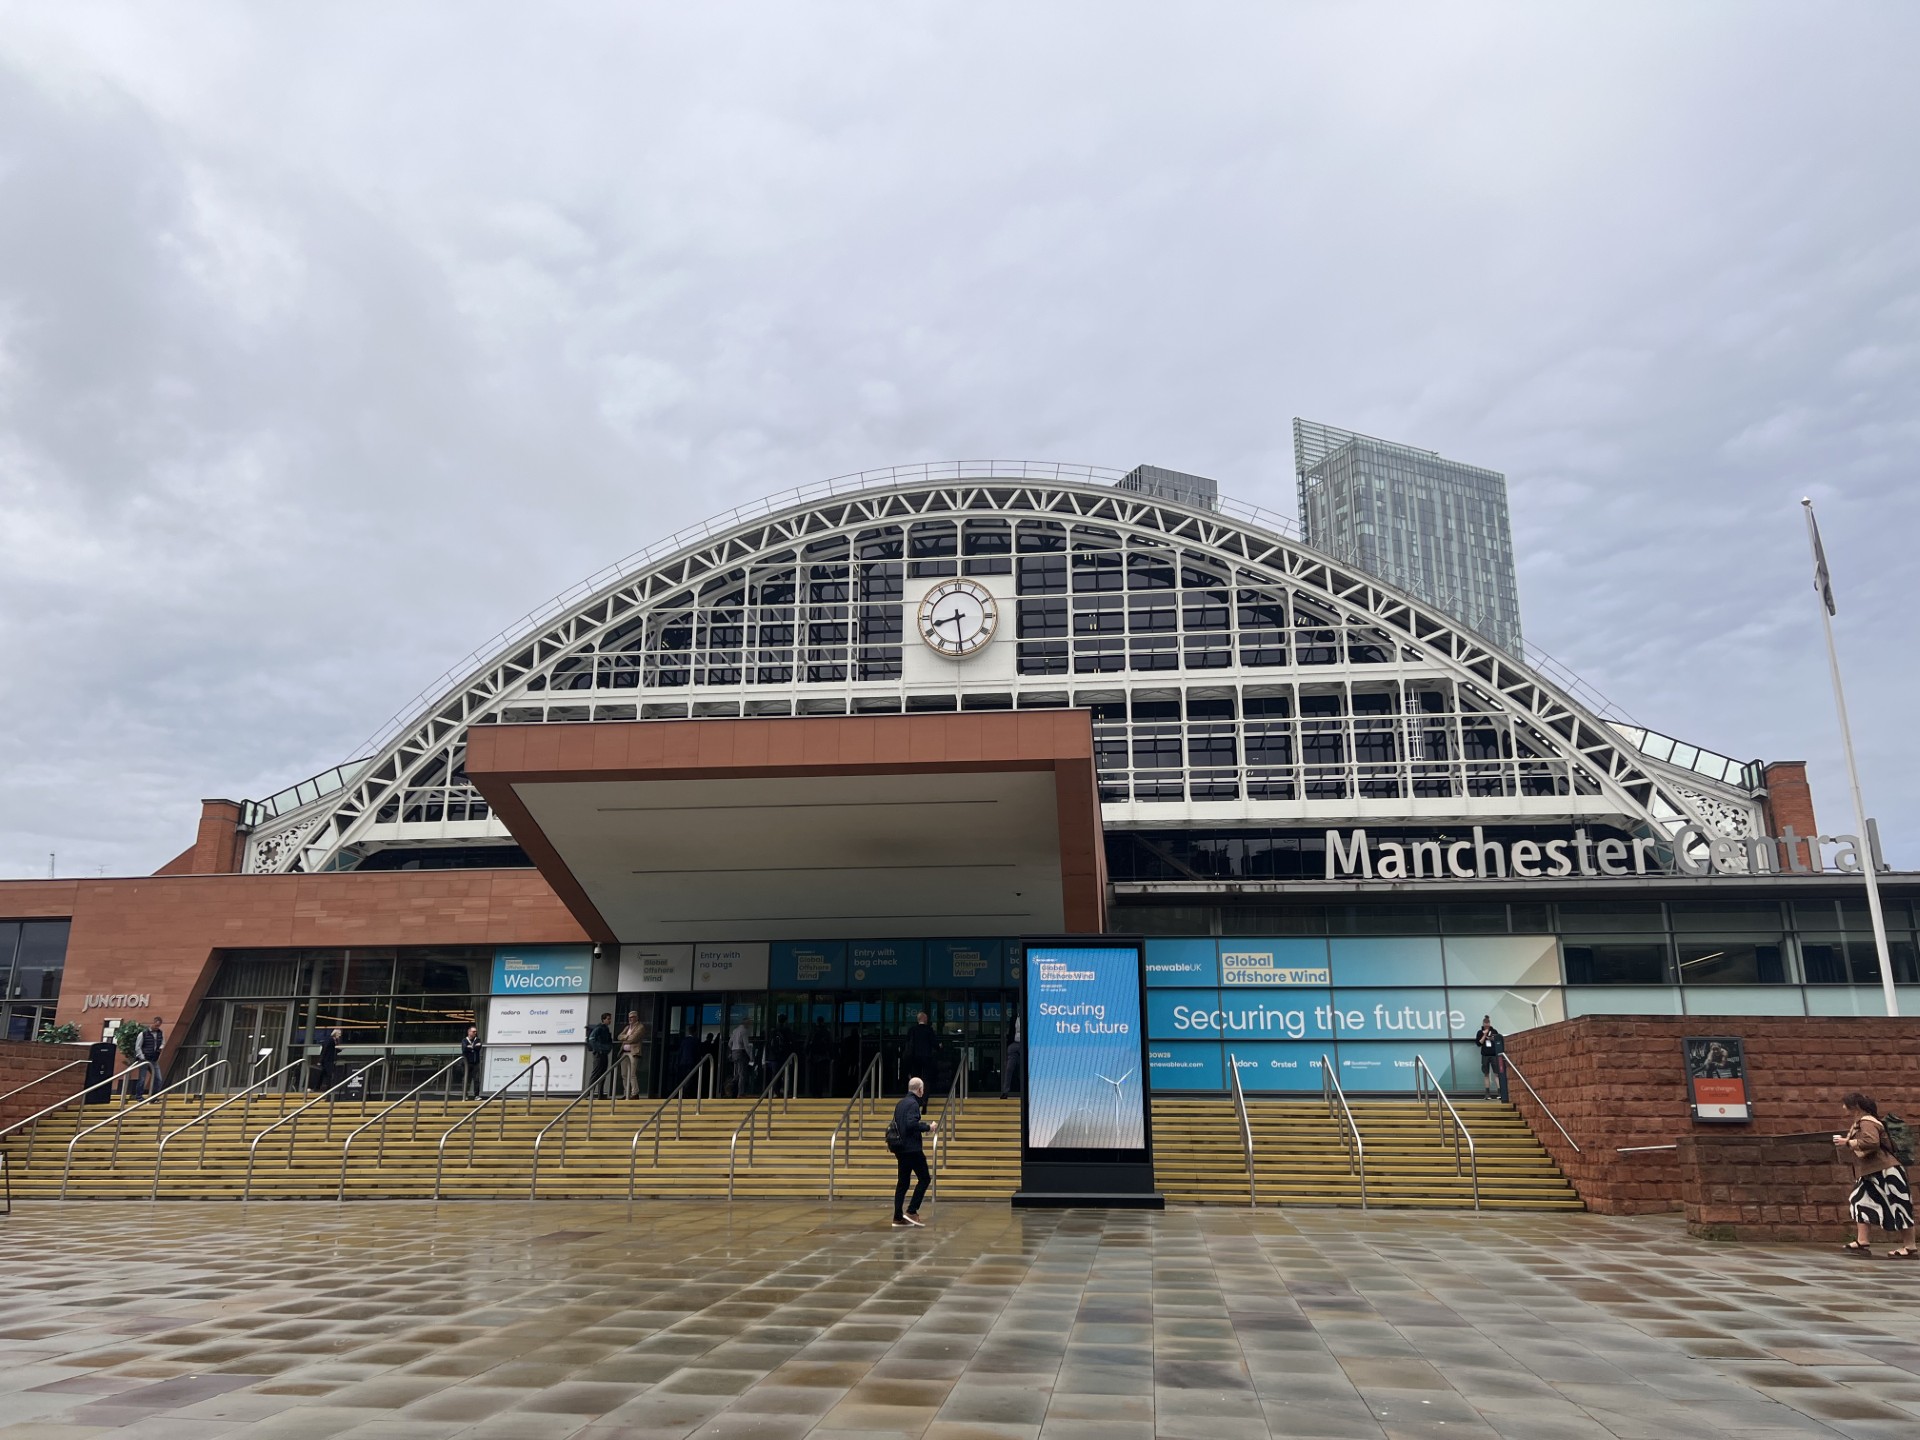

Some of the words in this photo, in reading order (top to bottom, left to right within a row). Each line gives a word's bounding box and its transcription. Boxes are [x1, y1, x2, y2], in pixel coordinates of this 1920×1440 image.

[1325, 826, 1655, 879] Manchester
[1673, 817, 1888, 876] Central
[700, 952, 722, 961] Entry
[722, 951, 741, 959] with
[854, 949, 876, 958] Entry
[877, 948, 896, 956] with
[711, 960, 733, 970] bags
[854, 958, 871, 968] bag
[872, 957, 898, 966] check
[1224, 955, 1271, 967] Global
[1145, 963, 1202, 972] enewableUK
[503, 973, 583, 988] Welcome
[1225, 970, 1287, 983] Offshore
[1289, 970, 1328, 983] Wind
[81, 993, 151, 1014] JUNCTION
[1039, 1002, 1105, 1020] Securing
[1056, 1020, 1081, 1034] the
[1084, 1020, 1129, 1034] future
[1173, 1005, 1306, 1039] Securing
[1314, 1005, 1365, 1030] the
[1373, 1003, 1466, 1030] future
[1227, 1059, 1259, 1068] ndara
